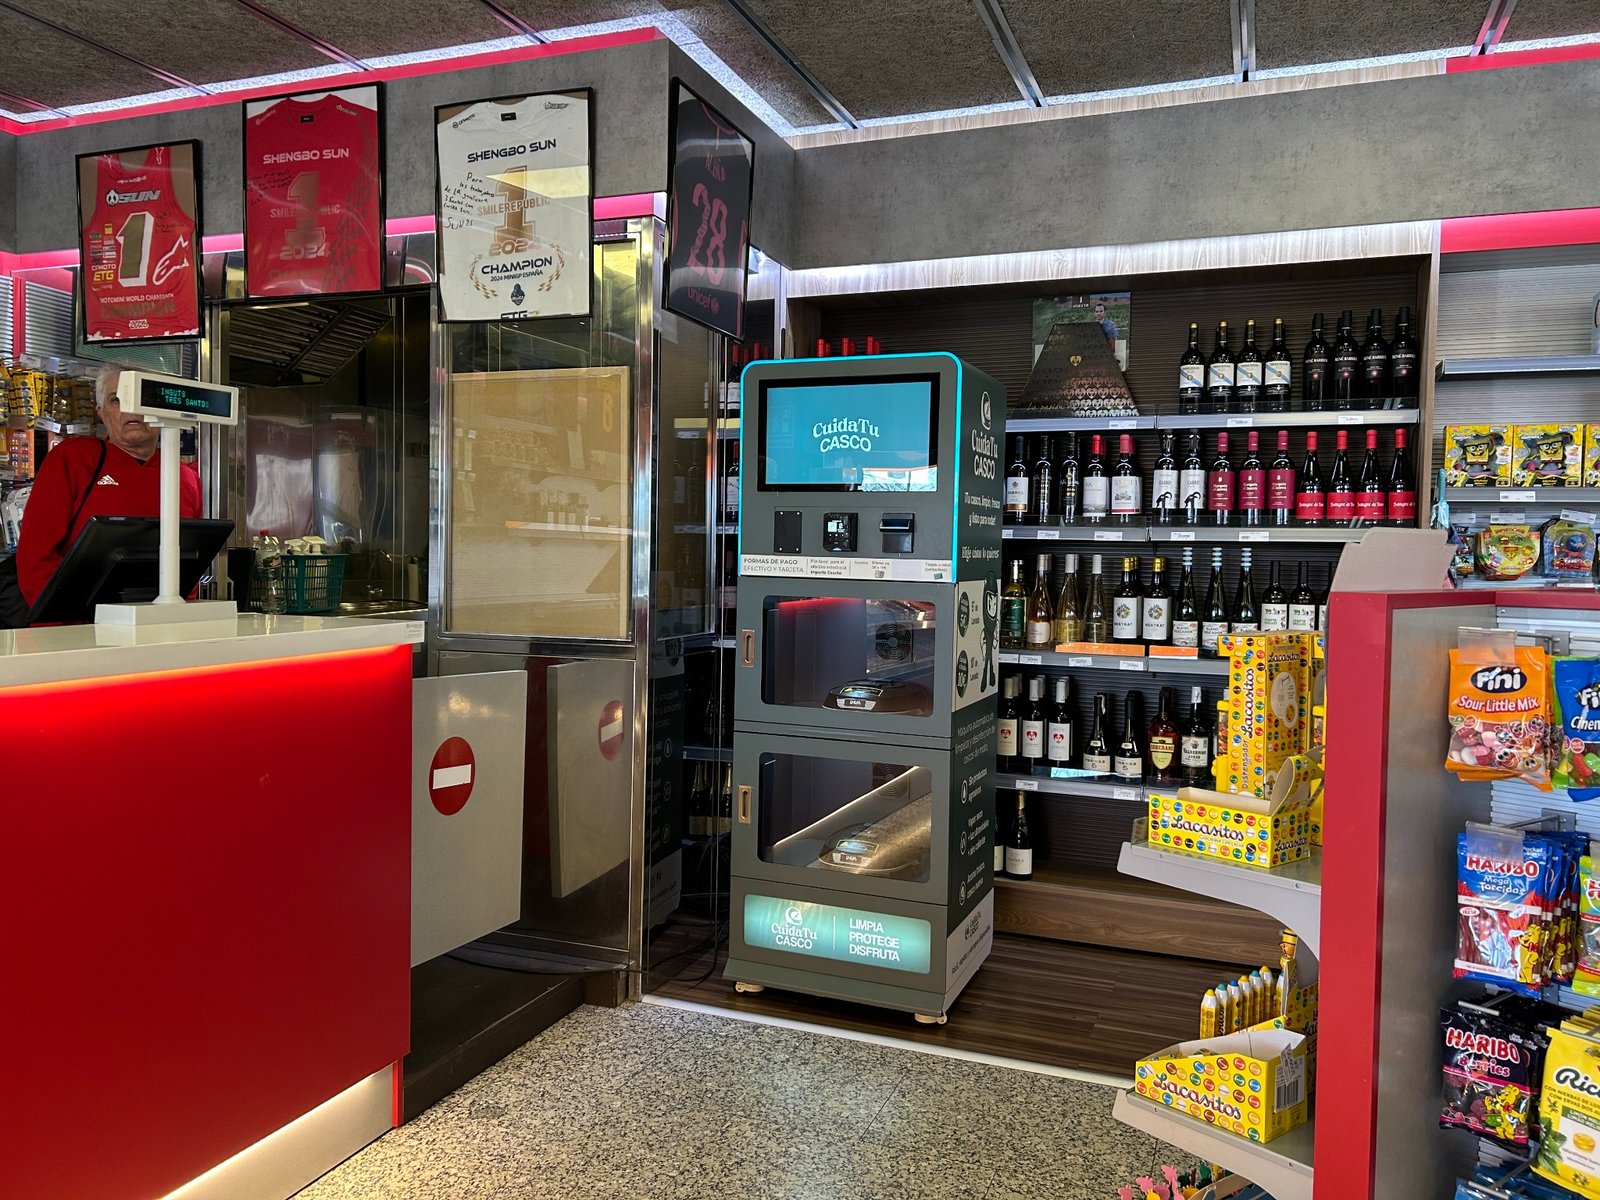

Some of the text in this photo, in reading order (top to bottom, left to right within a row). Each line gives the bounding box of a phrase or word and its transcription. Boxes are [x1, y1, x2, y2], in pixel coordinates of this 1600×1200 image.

[262, 148, 349, 165] SHENGBO SUN
[467, 138, 556, 163] SHENGBO SUN
[119, 189, 160, 203] SUN
[477, 197, 551, 216] SMILEREPUBLIC
[687, 182, 727, 286] 28
[481, 256, 553, 275] CHAMPION
[93, 270, 114, 281] ETG
[165, 396, 209, 408] TRES SANTOS
[820, 434, 871, 453] CASCO
[974, 454, 996, 480] CASCO
[1268, 653, 1300, 663] Lacasitos
[1476, 667, 1521, 691] Fini
[1241, 668, 1255, 738] Lacasitos
[1459, 695, 1539, 712] Sour Little Mix
[1170, 815, 1244, 841] Lacasitos
[1479, 882, 1526, 896] Torcidas
[1483, 876, 1510, 885] Mega
[849, 918, 884, 934] LIMPIA
[776, 935, 812, 950] CASCO
[849, 931, 900, 949] PROTEGE
[849, 945, 900, 962] DISFRUTA
[1446, 1028, 1520, 1064] HARIBO
[1458, 1056, 1510, 1078] Berries
[1152, 1072, 1241, 1120] Lacasitos
[1545, 1085, 1557, 1093] CON
[1549, 1093, 1563, 1101] COM
